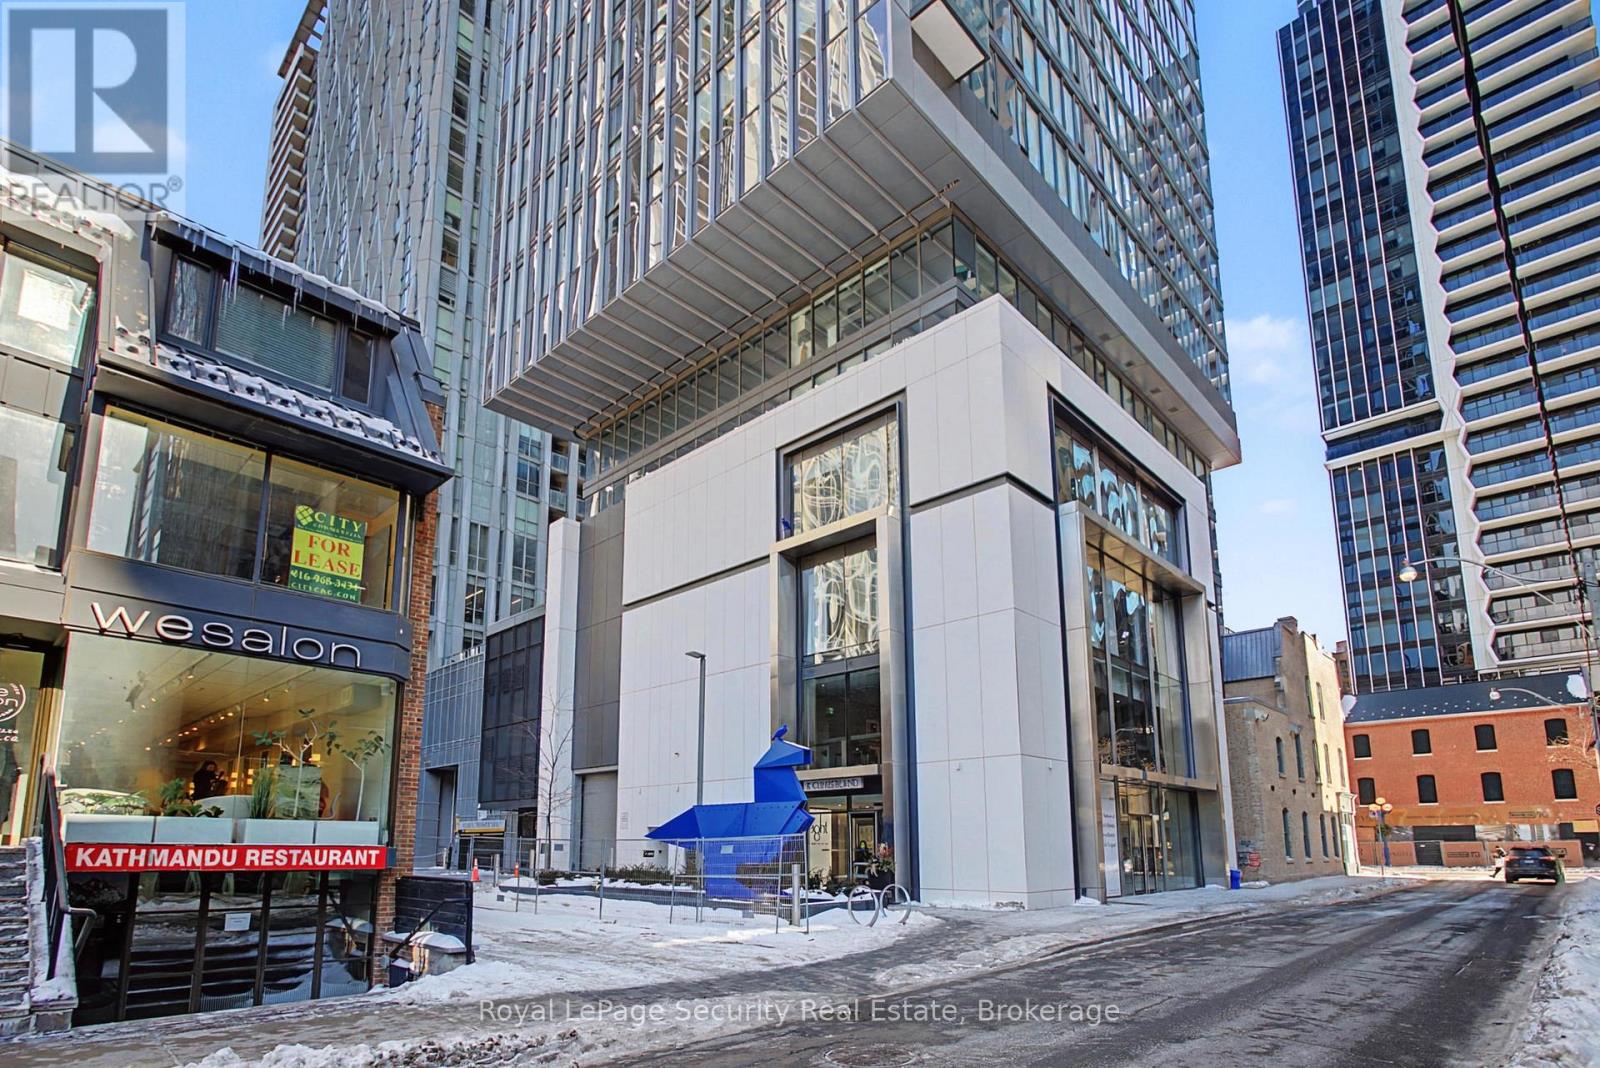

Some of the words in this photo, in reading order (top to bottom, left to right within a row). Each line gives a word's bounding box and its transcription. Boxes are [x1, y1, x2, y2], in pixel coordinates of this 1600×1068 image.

[314, 511, 362, 532] CITY
[309, 534, 351, 557] FOR
[294, 550, 361, 578] LEASE
[91, 602, 361, 667] wesalon
[75, 847, 238, 867] KATHMANDU
[244, 849, 380, 866] RESTAURANT
